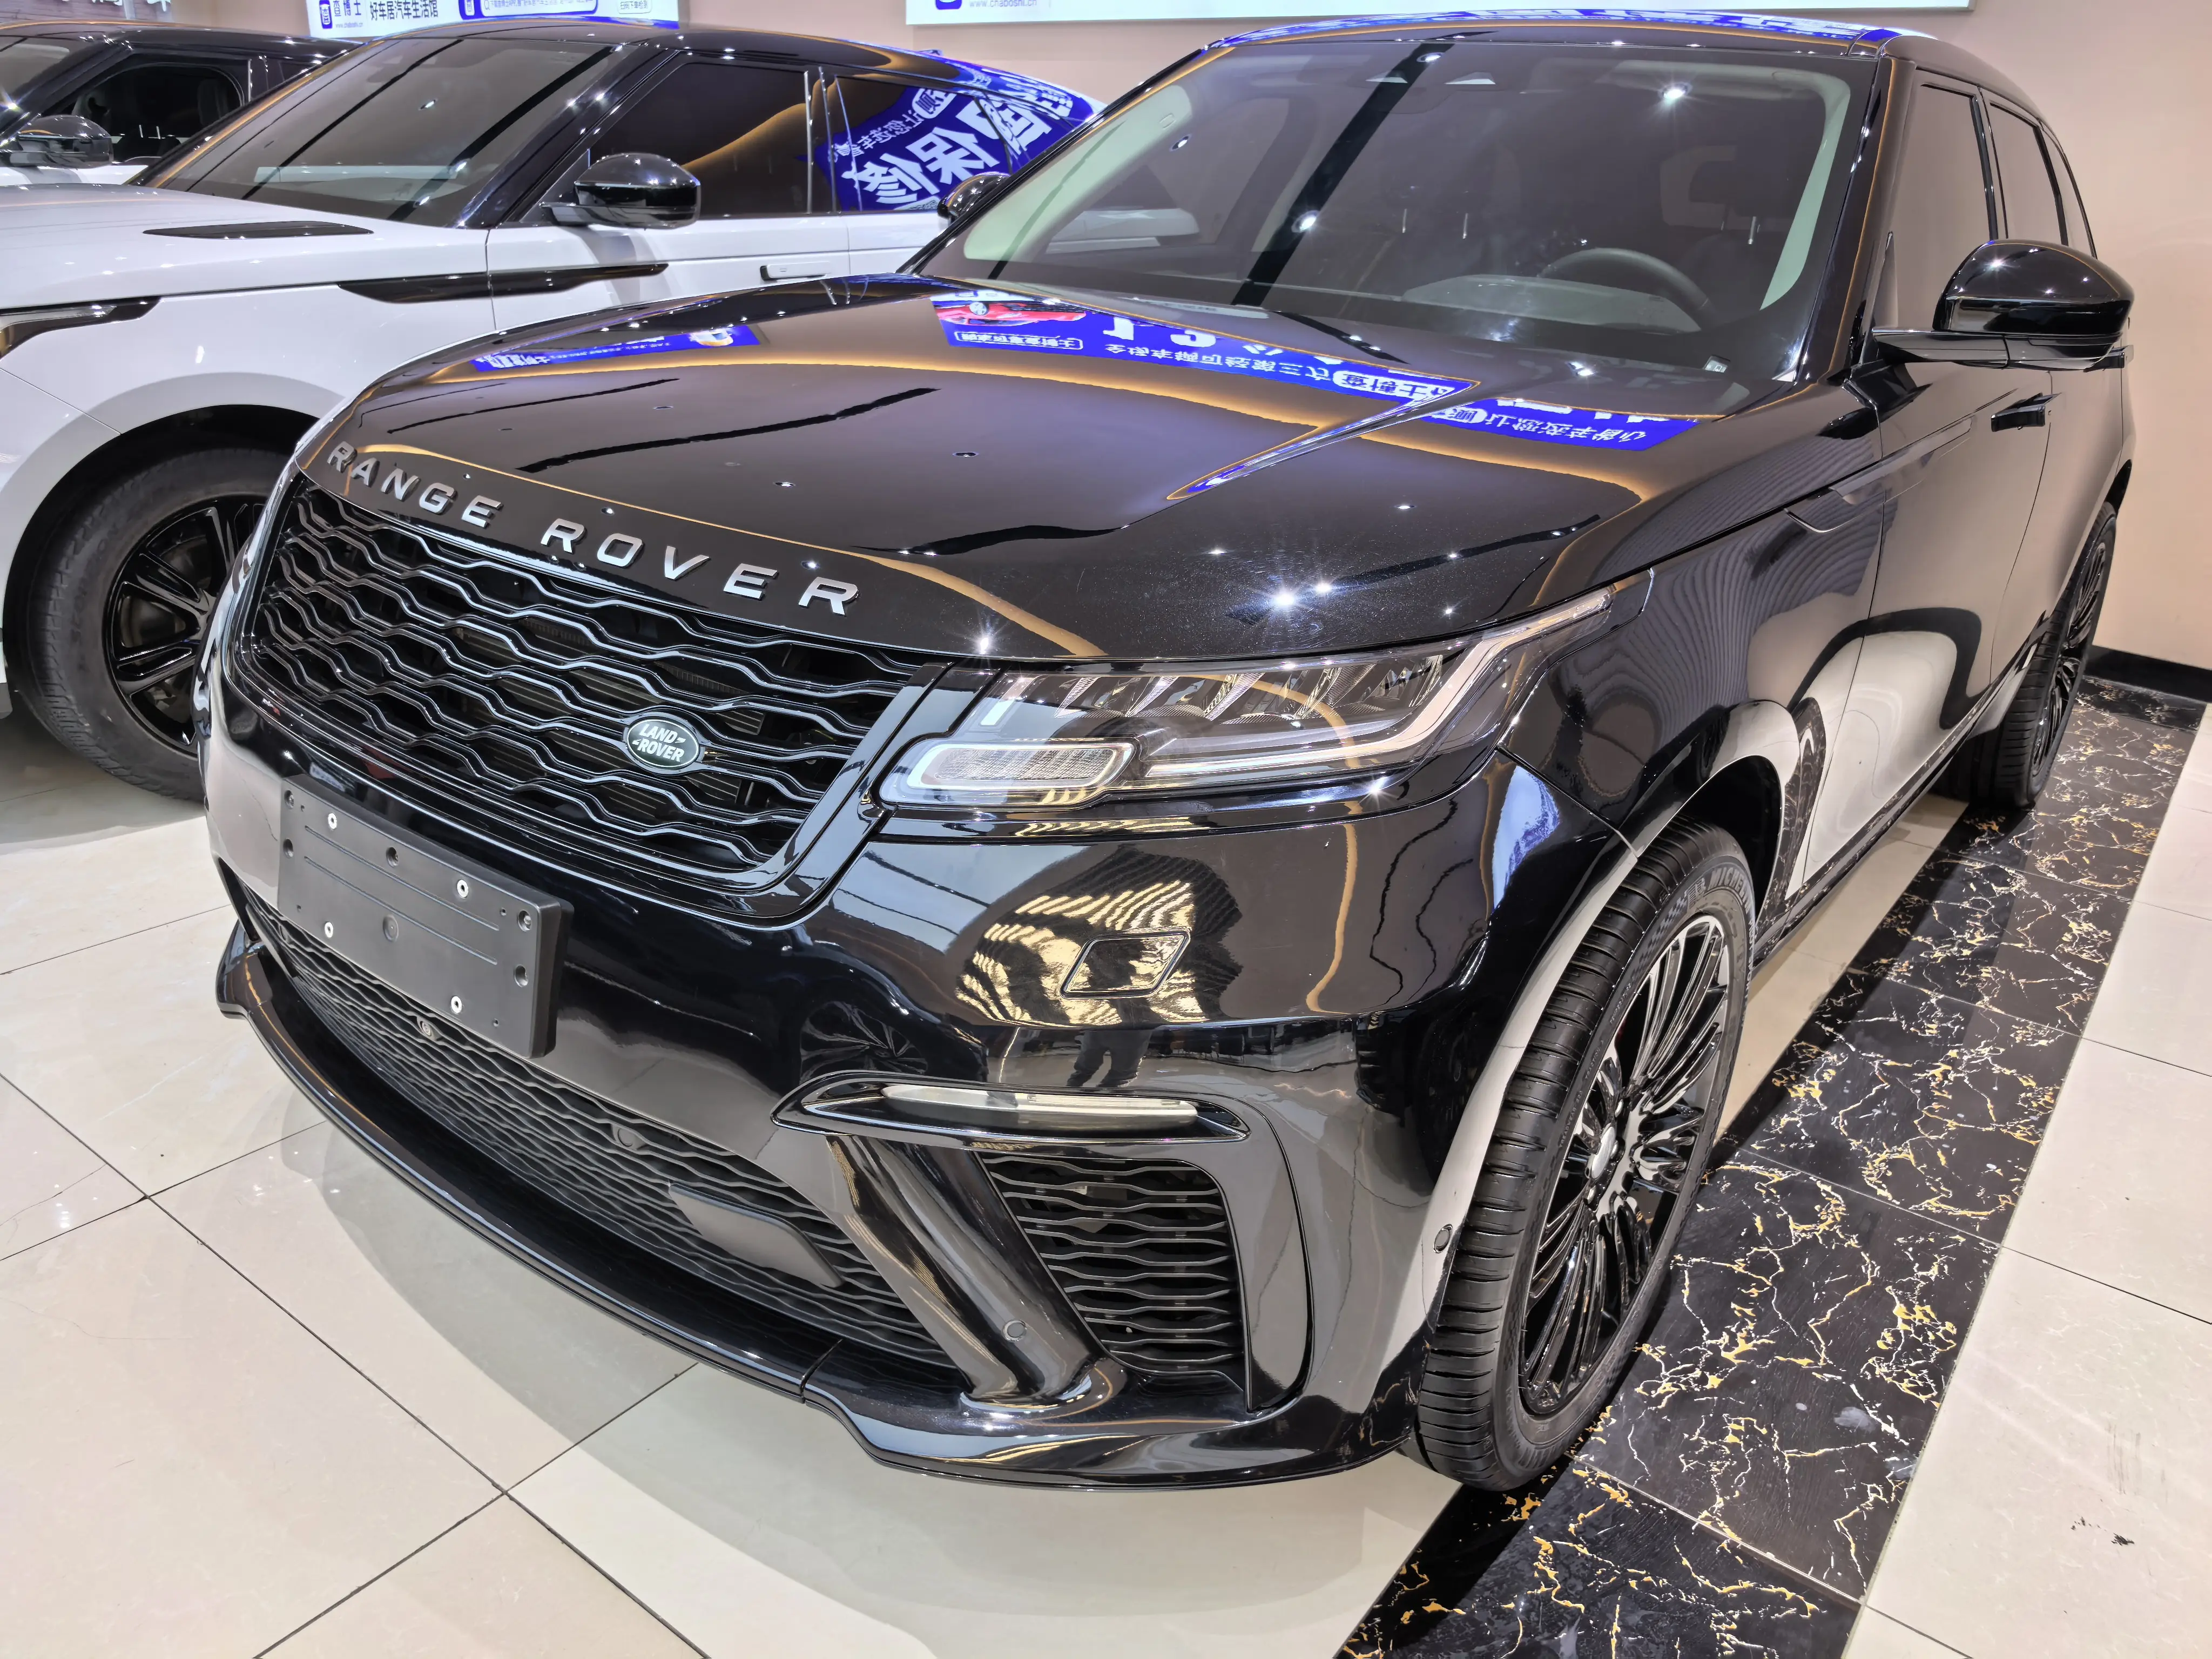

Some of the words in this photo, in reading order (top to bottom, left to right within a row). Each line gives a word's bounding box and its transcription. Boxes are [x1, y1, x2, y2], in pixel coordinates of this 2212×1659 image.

[327, 441, 503, 529] RANGE
[541, 518, 859, 616] ROVER
[639, 724, 678, 744] LAND
[637, 739, 685, 762] ROVER
